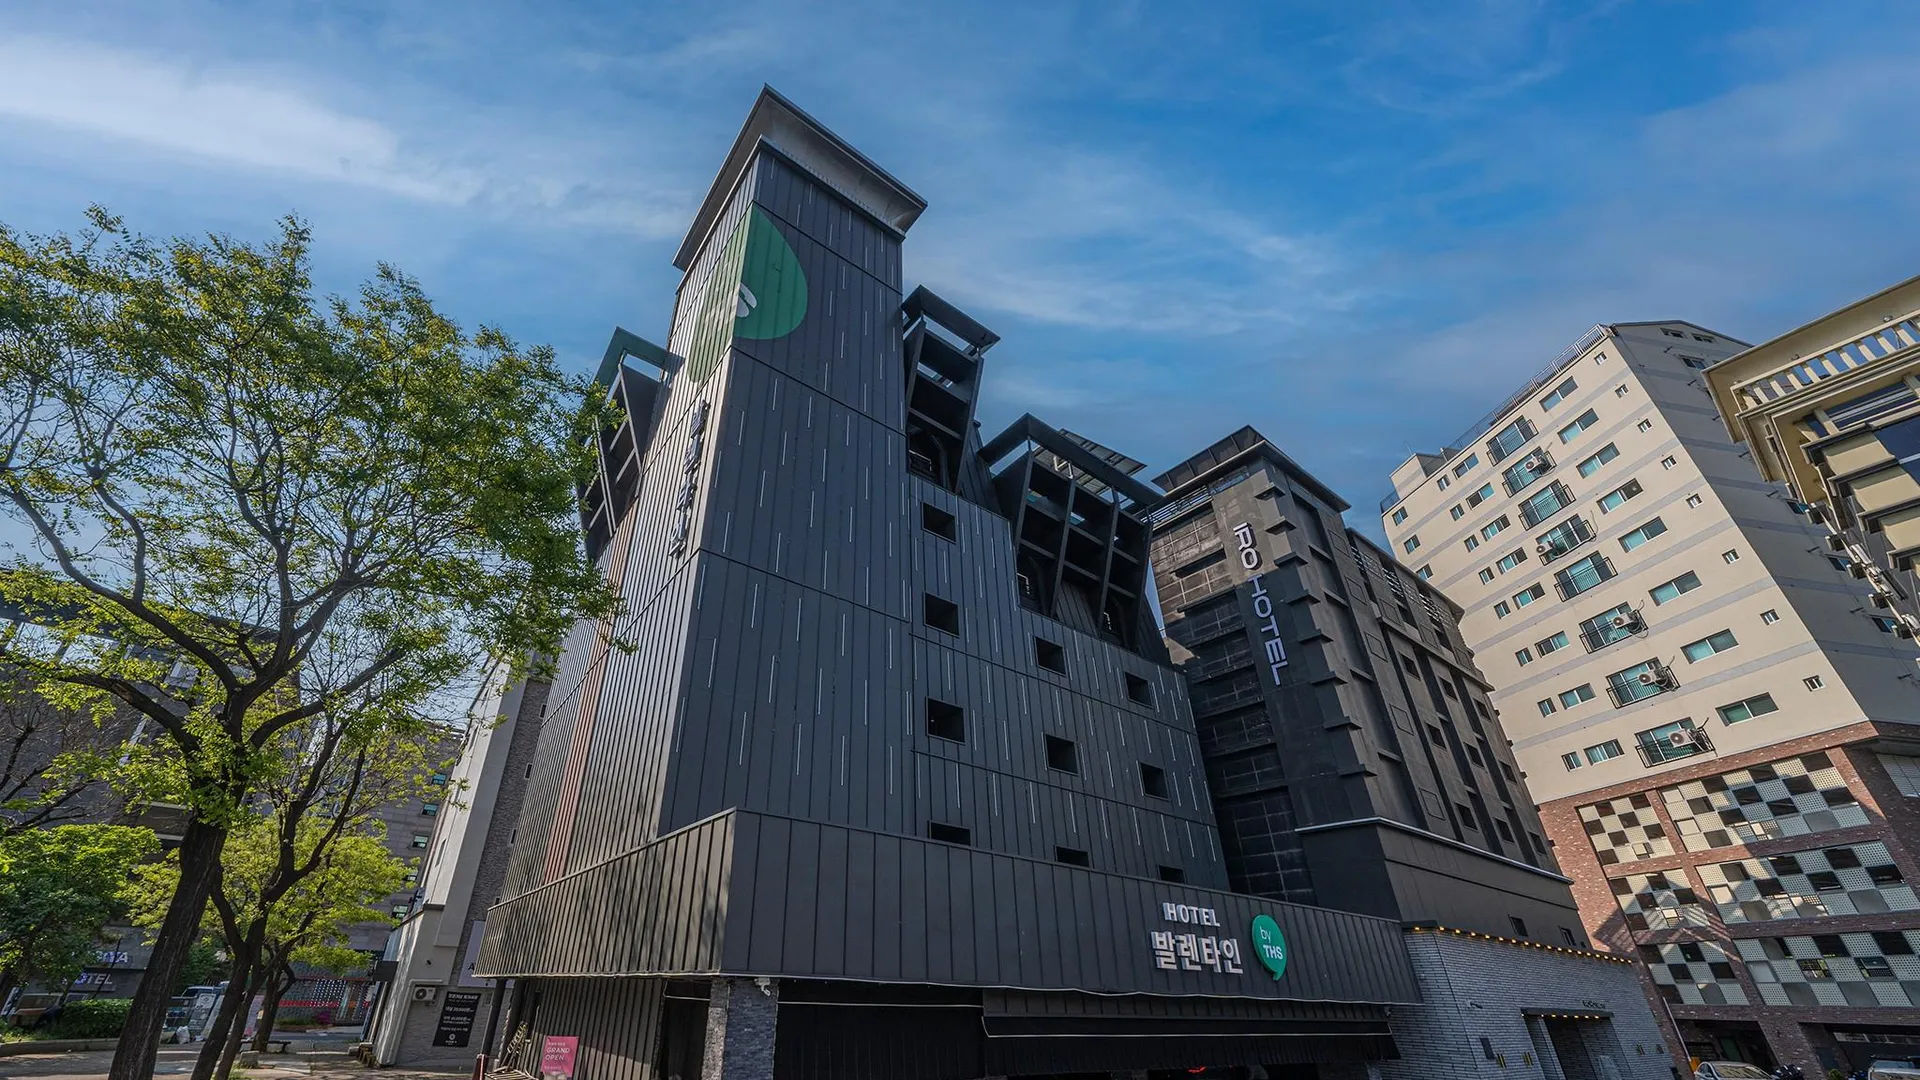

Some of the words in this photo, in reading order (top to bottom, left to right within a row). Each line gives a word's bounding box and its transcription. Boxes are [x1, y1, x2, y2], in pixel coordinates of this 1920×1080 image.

[1233, 522, 1260, 569] IRO
[1248, 573, 1289, 686] HOTEL
[1162, 902, 1221, 927] HOTEL
[1259, 926, 1272, 943] by
[1151, 931, 1244, 974] 발렌타인
[1262, 944, 1283, 960] THS
